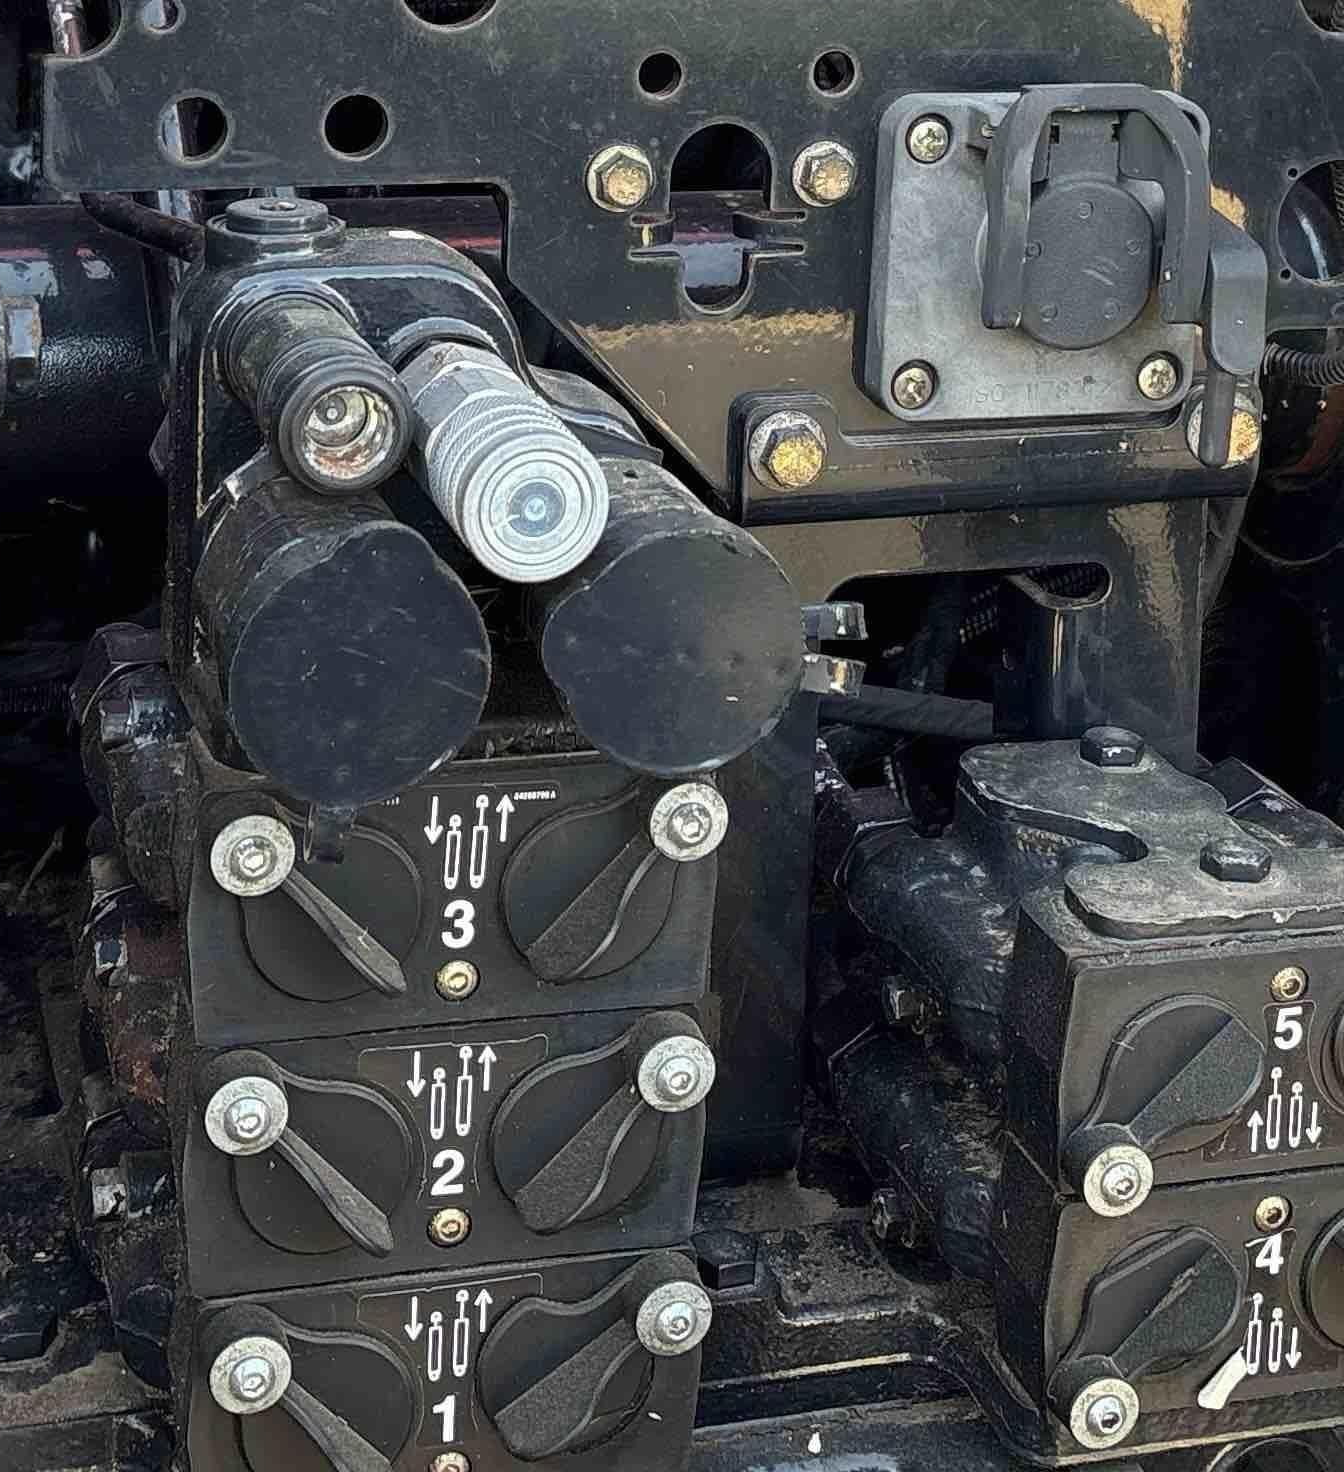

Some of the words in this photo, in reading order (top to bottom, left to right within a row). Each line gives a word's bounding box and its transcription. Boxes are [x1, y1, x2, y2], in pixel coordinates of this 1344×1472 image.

[441, 899, 476, 950] 3
[1273, 1006, 1304, 1050] 5
[431, 1149, 464, 1197] 2
[1256, 1232, 1285, 1275] 4
[431, 1395, 457, 1443] 1
